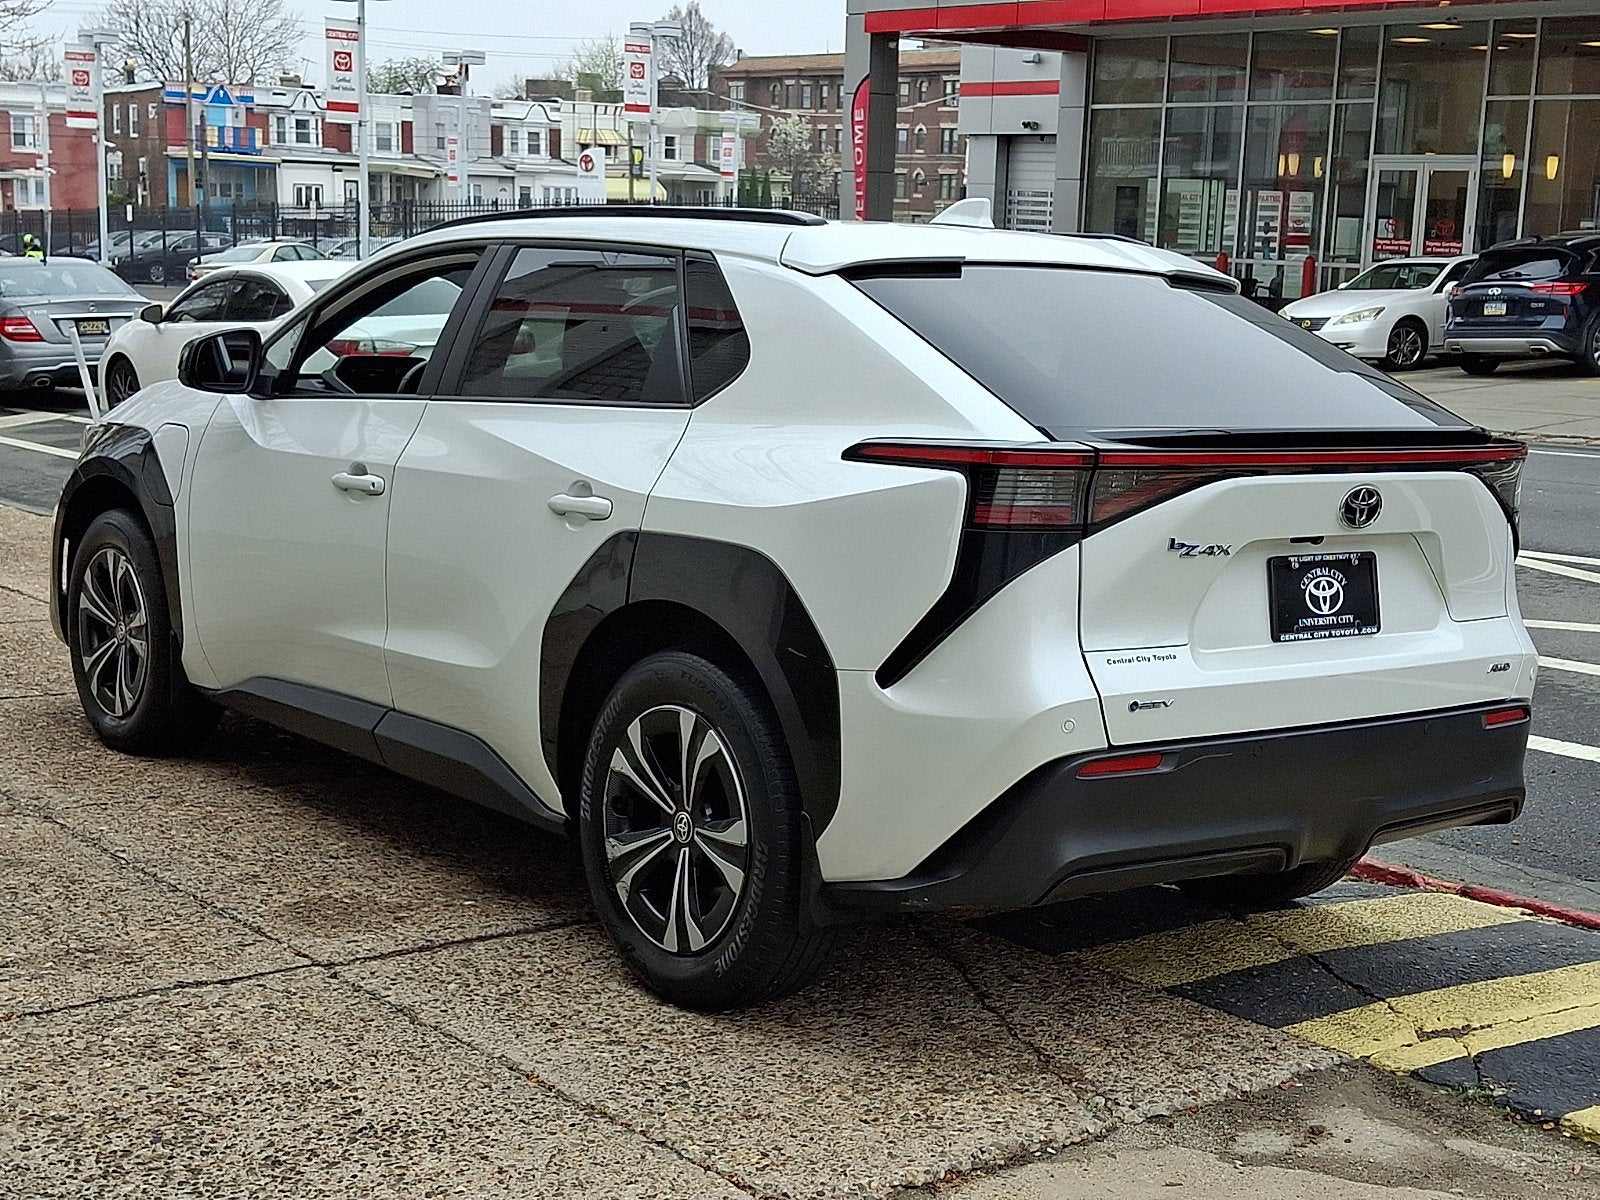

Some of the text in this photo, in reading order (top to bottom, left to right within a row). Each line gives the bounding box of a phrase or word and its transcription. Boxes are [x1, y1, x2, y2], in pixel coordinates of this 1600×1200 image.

[1300, 566, 1348, 590] CENTRAL CITY
[1298, 614, 1354, 627] UNIVERSITY CITY
[1280, 631, 1312, 641] CENTRAL
[1313, 630, 1331, 638] CITY
[1331, 629, 1359, 637] TOYOTA
[1106, 653, 1177, 666] Central City Toyota
[1487, 662, 1511, 674] AWD
[580, 688, 624, 822] BRIDGESTONE
[714, 838, 769, 978] BRIDGESTONE
